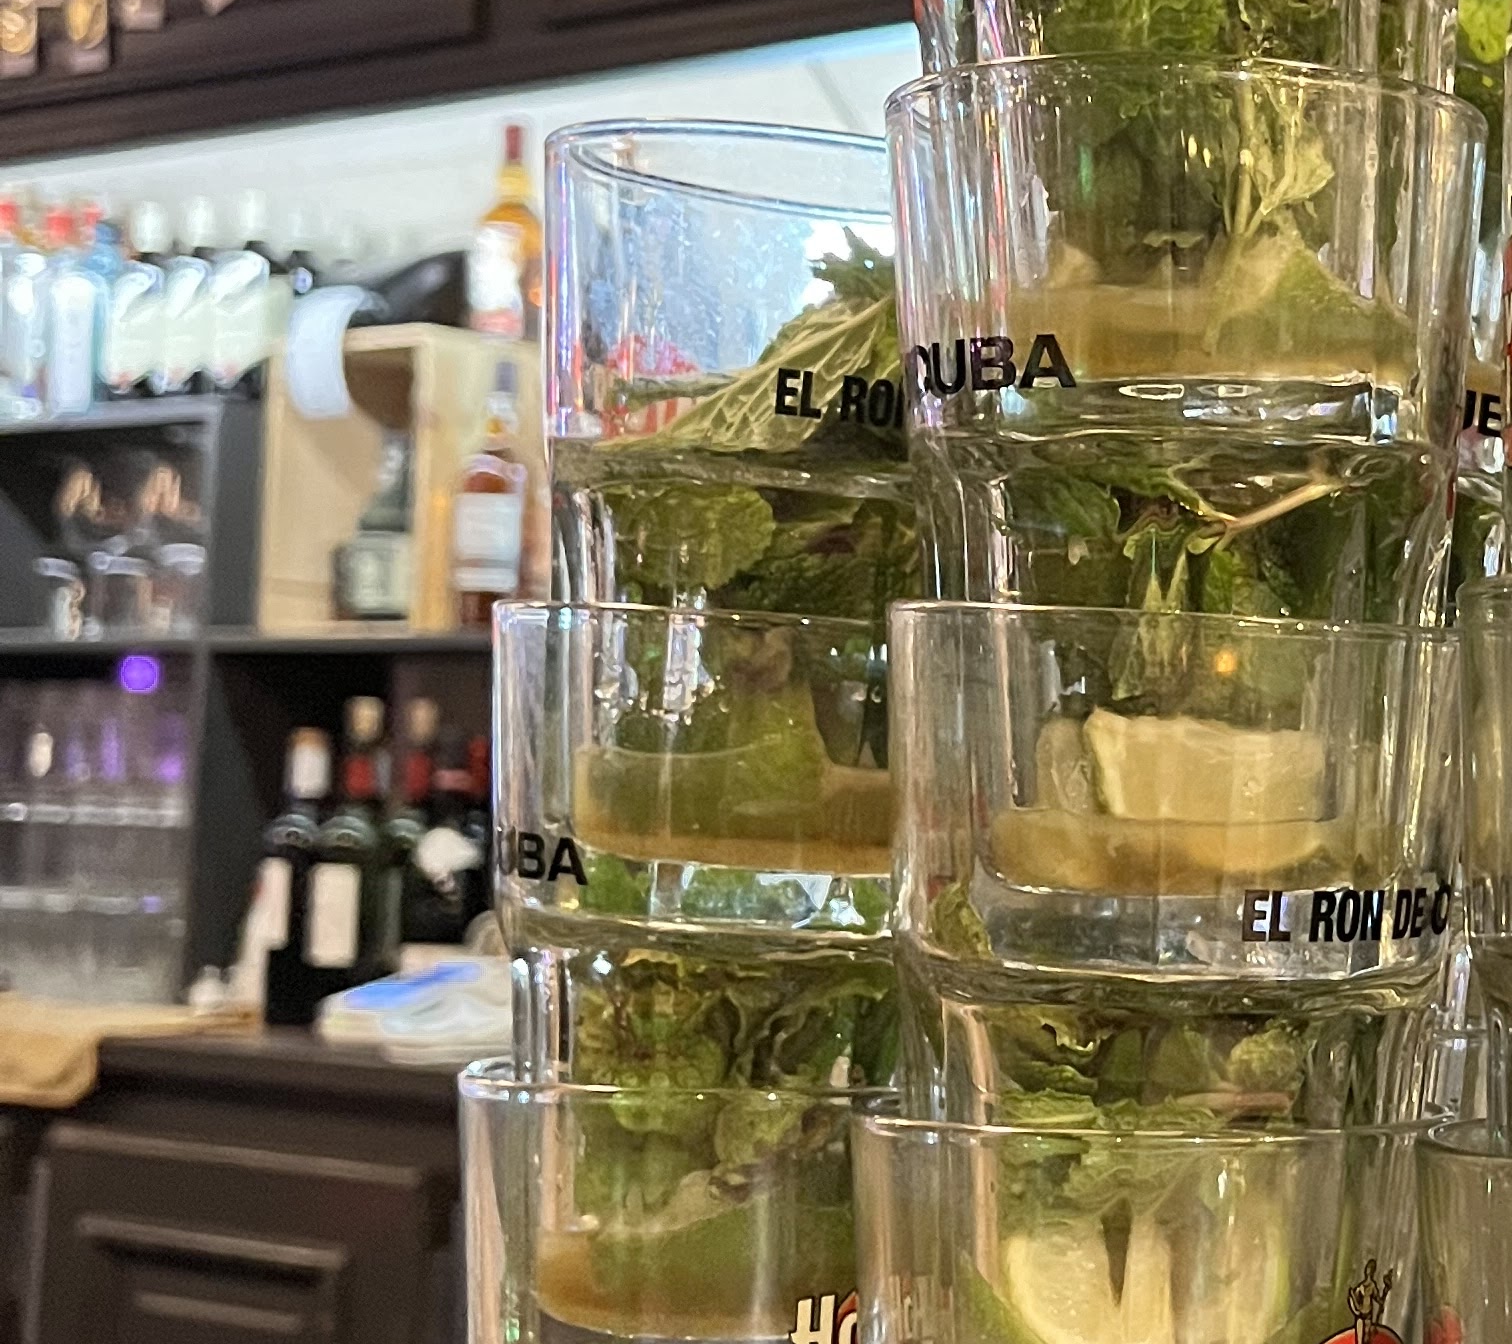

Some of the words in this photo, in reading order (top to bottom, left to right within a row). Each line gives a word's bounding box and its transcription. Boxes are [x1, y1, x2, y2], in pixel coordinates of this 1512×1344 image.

[775, 367, 822, 419] EL
[1241, 889, 1290, 943] EL
[1309, 887, 1385, 943] RON
[1392, 888, 1427, 940] DE
